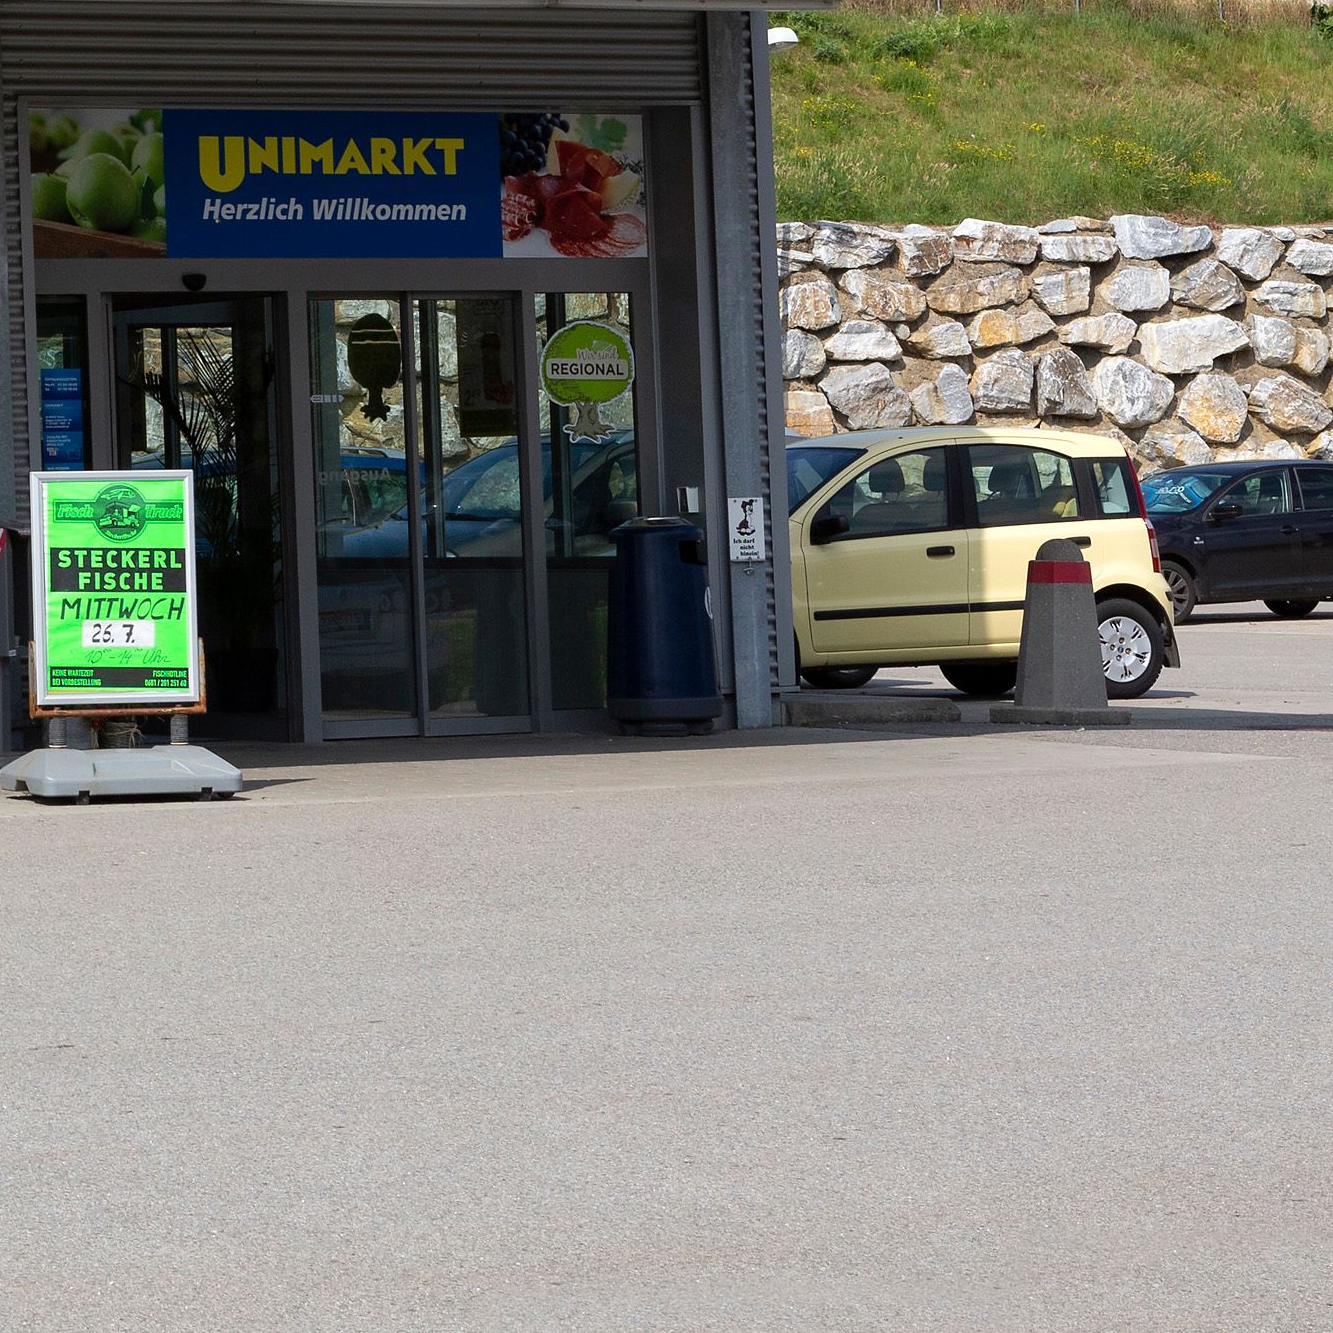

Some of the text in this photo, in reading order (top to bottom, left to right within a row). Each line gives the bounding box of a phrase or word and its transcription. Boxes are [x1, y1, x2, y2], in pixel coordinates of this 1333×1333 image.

[198, 135, 464, 193] UNIMARKT
[202, 197, 467, 221] Herzlich Willkommen
[551, 363, 624, 375] REGIONAL
[57, 504, 183, 519] Fisch Truck
[58, 550, 182, 568] STECKERL
[78, 572, 163, 590] FISCHE
[60, 597, 185, 620] MITTWOCH
[91, 623, 135, 643] 26. 7.
[143, 648, 171, 664] Uhr
[52, 669, 67, 677] KEINE
[52, 678, 61, 686] BEI
